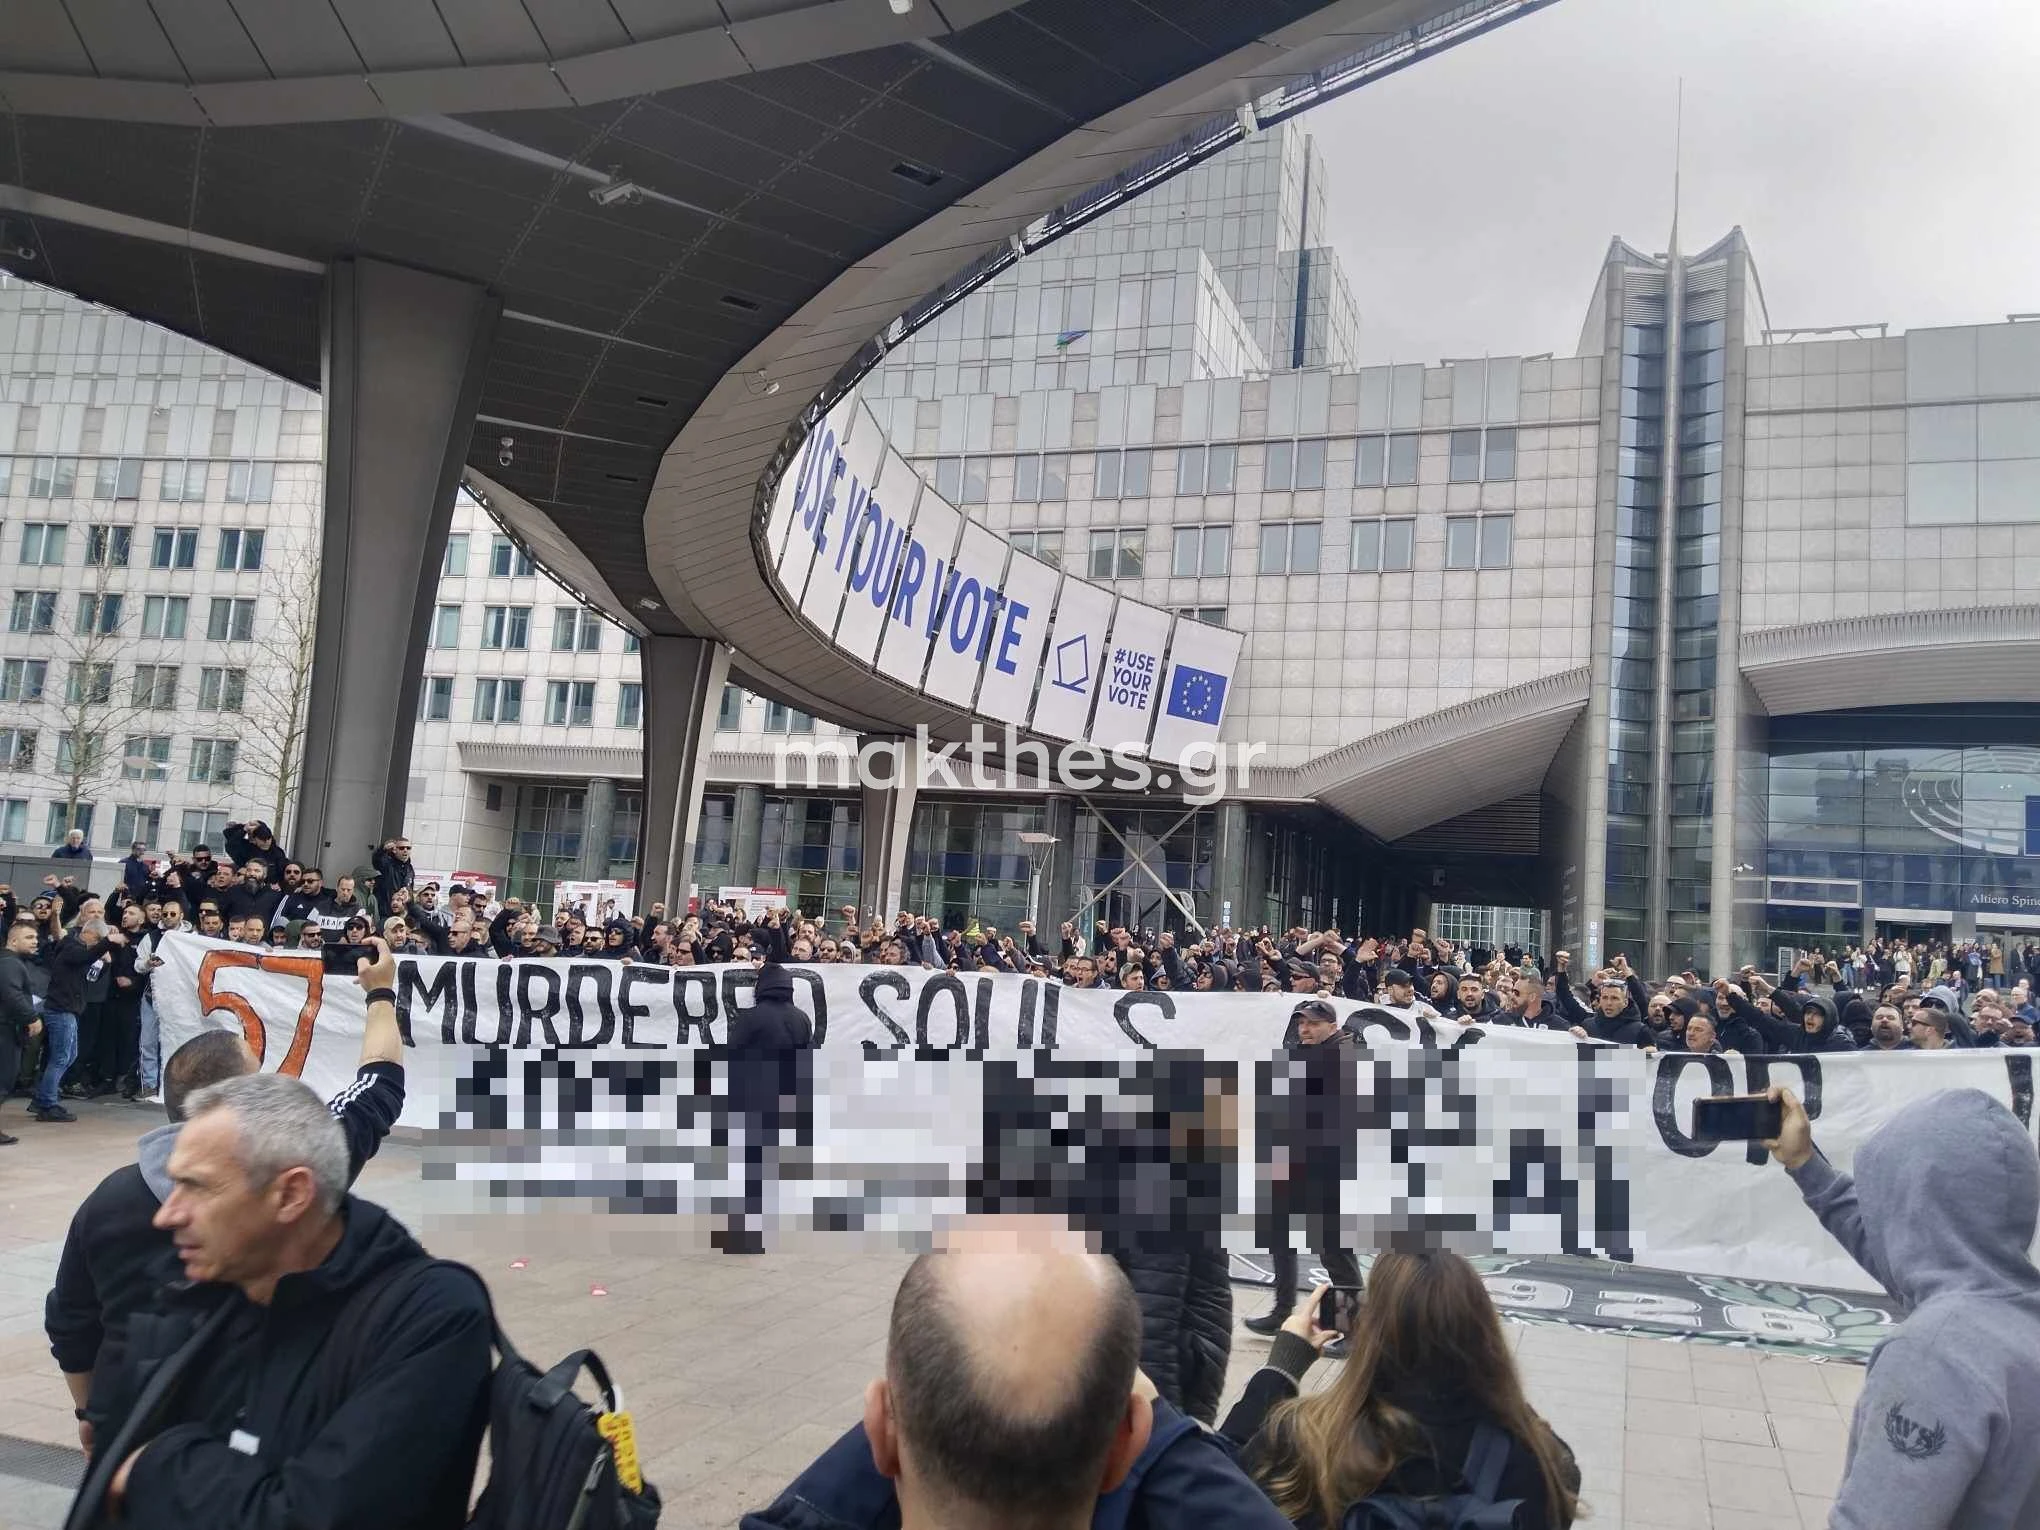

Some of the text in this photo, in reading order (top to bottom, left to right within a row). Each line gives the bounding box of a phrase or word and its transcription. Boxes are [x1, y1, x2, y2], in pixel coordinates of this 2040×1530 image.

[794, 417, 1031, 676] USE YOUR VOTE
[1114, 648, 1156, 674] #USE
[1112, 665, 1152, 692] YOUR
[1108, 685, 1148, 711] VOTE
[198, 949, 324, 1080] 57
